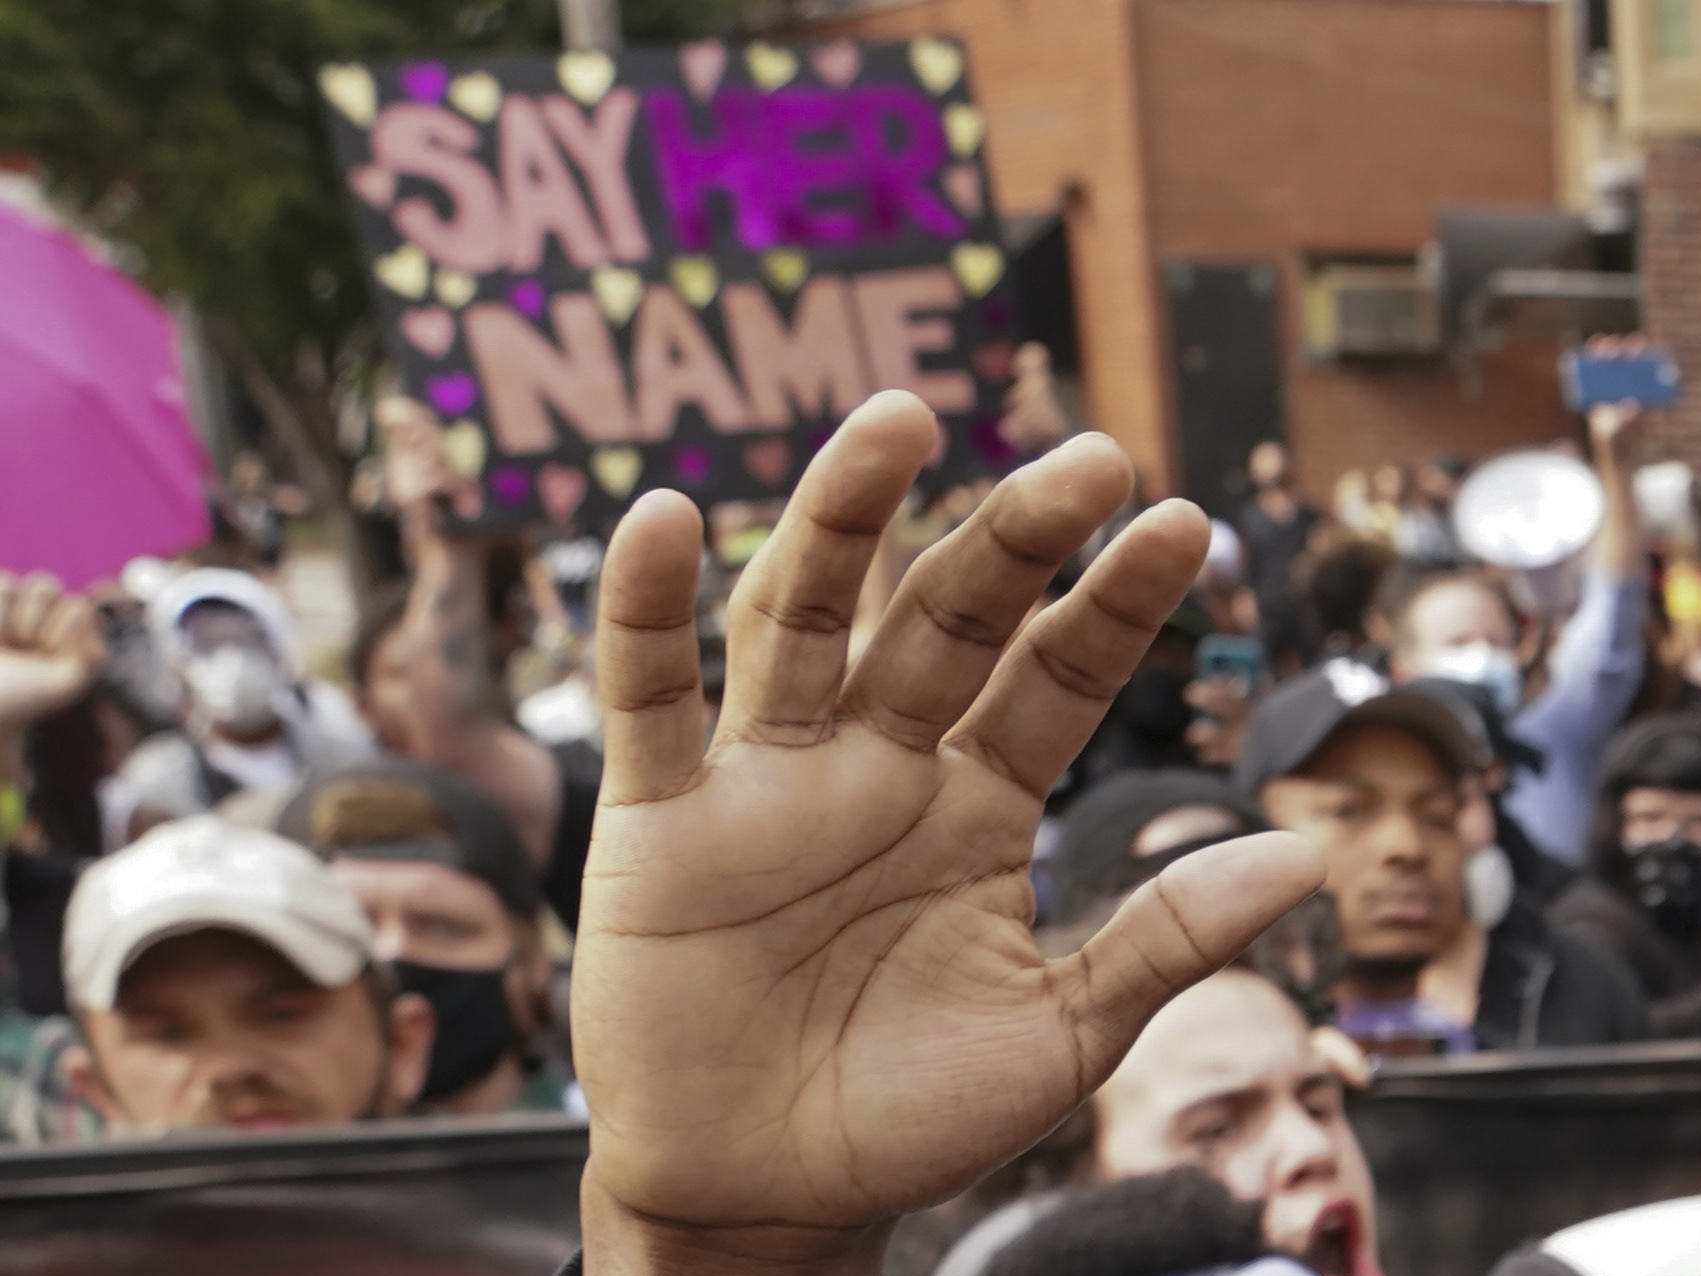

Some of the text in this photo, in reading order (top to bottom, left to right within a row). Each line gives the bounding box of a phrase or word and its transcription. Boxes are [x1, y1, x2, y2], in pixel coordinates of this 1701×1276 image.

[370, 87, 967, 273] SAY HER
[465, 265, 975, 455] NAME
